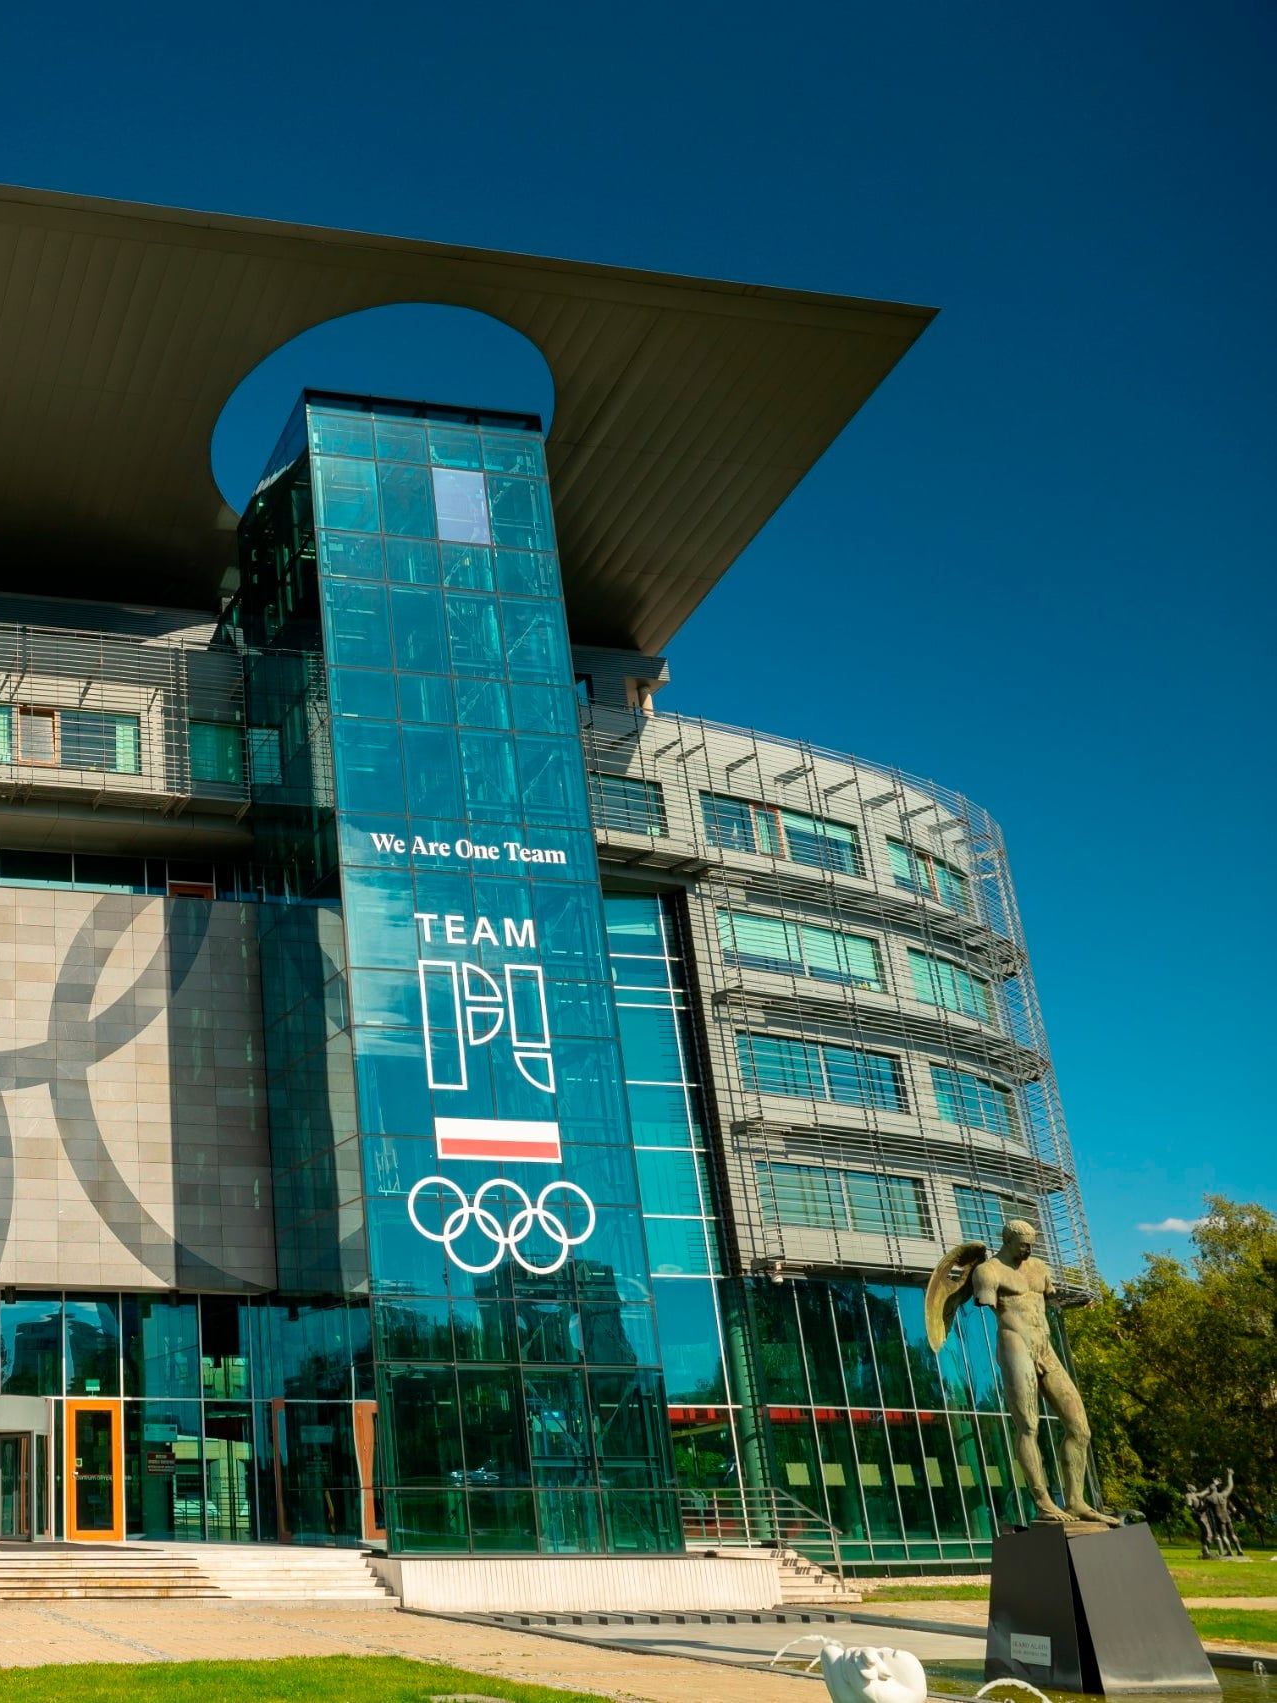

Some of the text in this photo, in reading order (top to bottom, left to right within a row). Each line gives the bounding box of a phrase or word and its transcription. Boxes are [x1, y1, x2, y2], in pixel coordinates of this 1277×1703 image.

[370, 832, 567, 865] We Are One Team
[413, 912, 536, 948] TEAM
